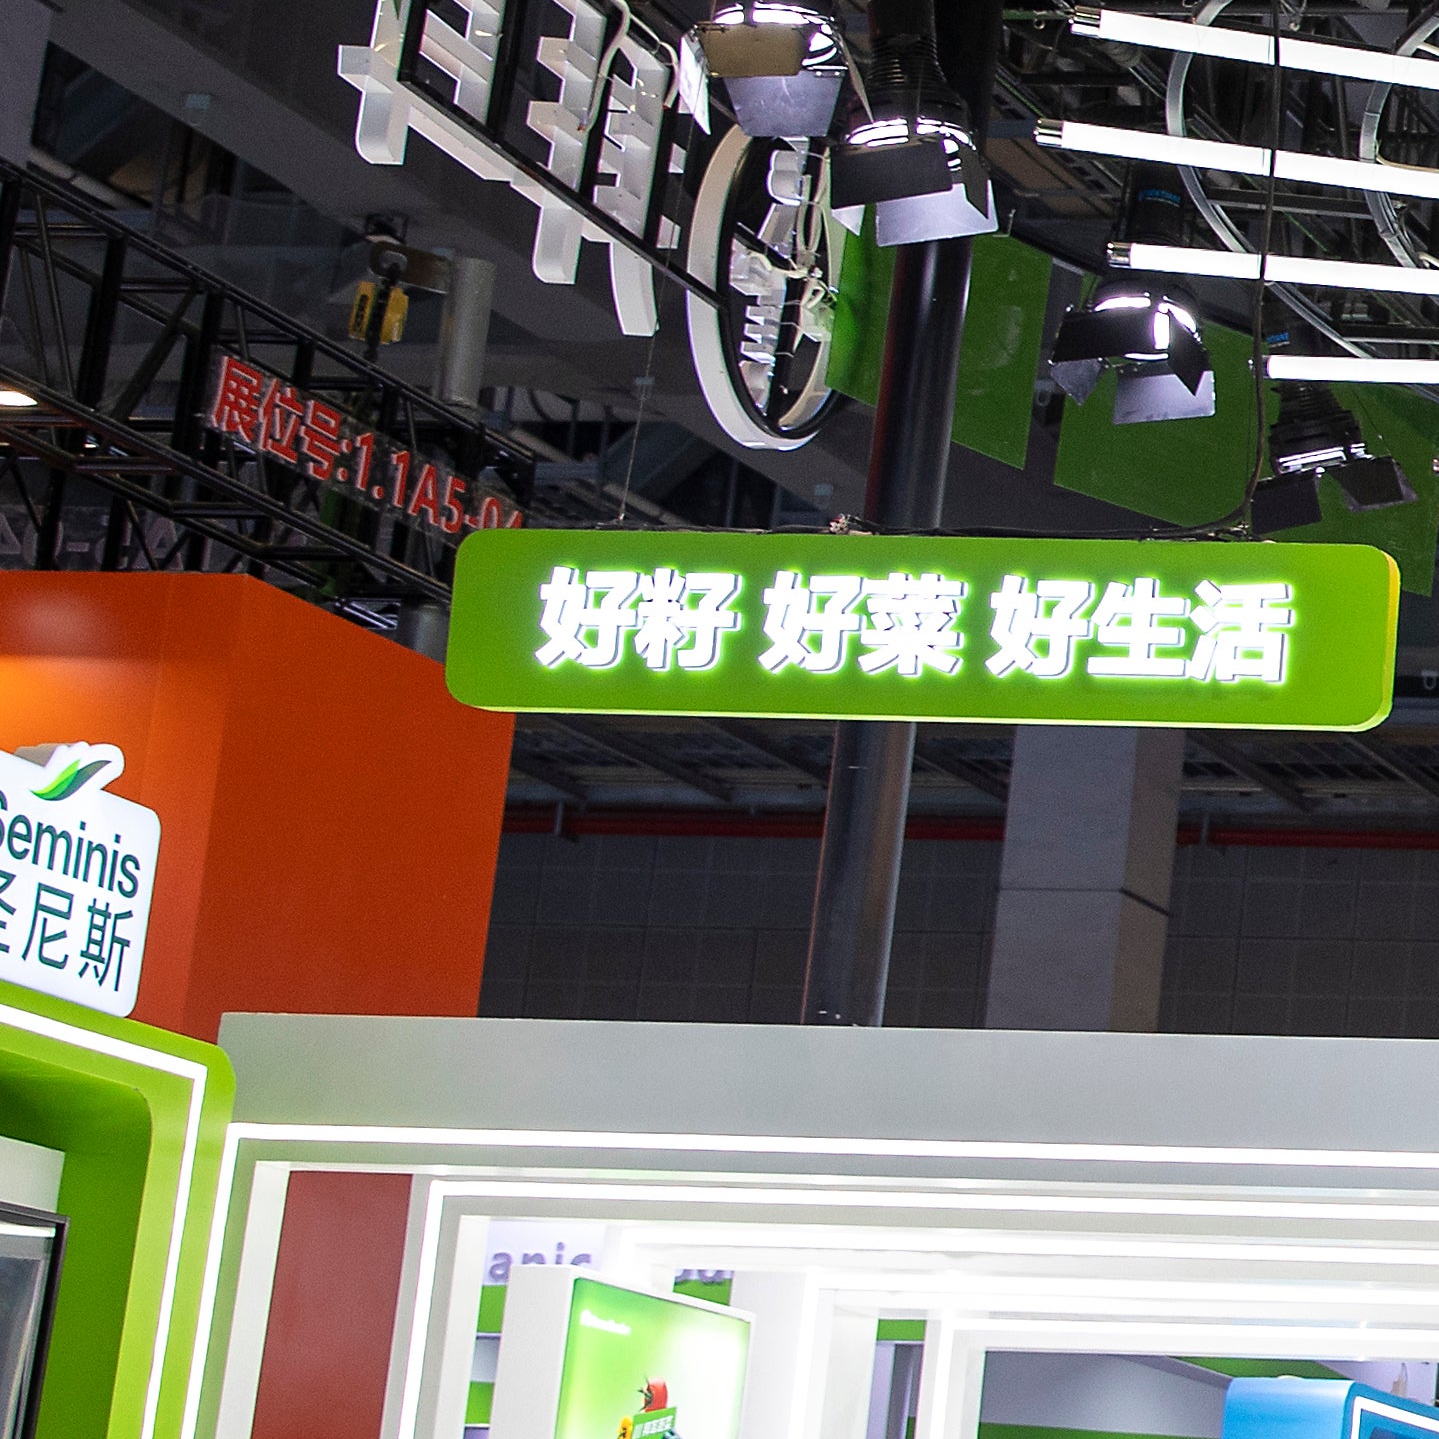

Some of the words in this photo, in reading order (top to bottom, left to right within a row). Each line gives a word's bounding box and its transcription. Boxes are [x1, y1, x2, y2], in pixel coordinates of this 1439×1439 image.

[534, 565, 744, 672] 好籽
[758, 569, 967, 677] 好菜
[988, 571, 1296, 683] 好生活
